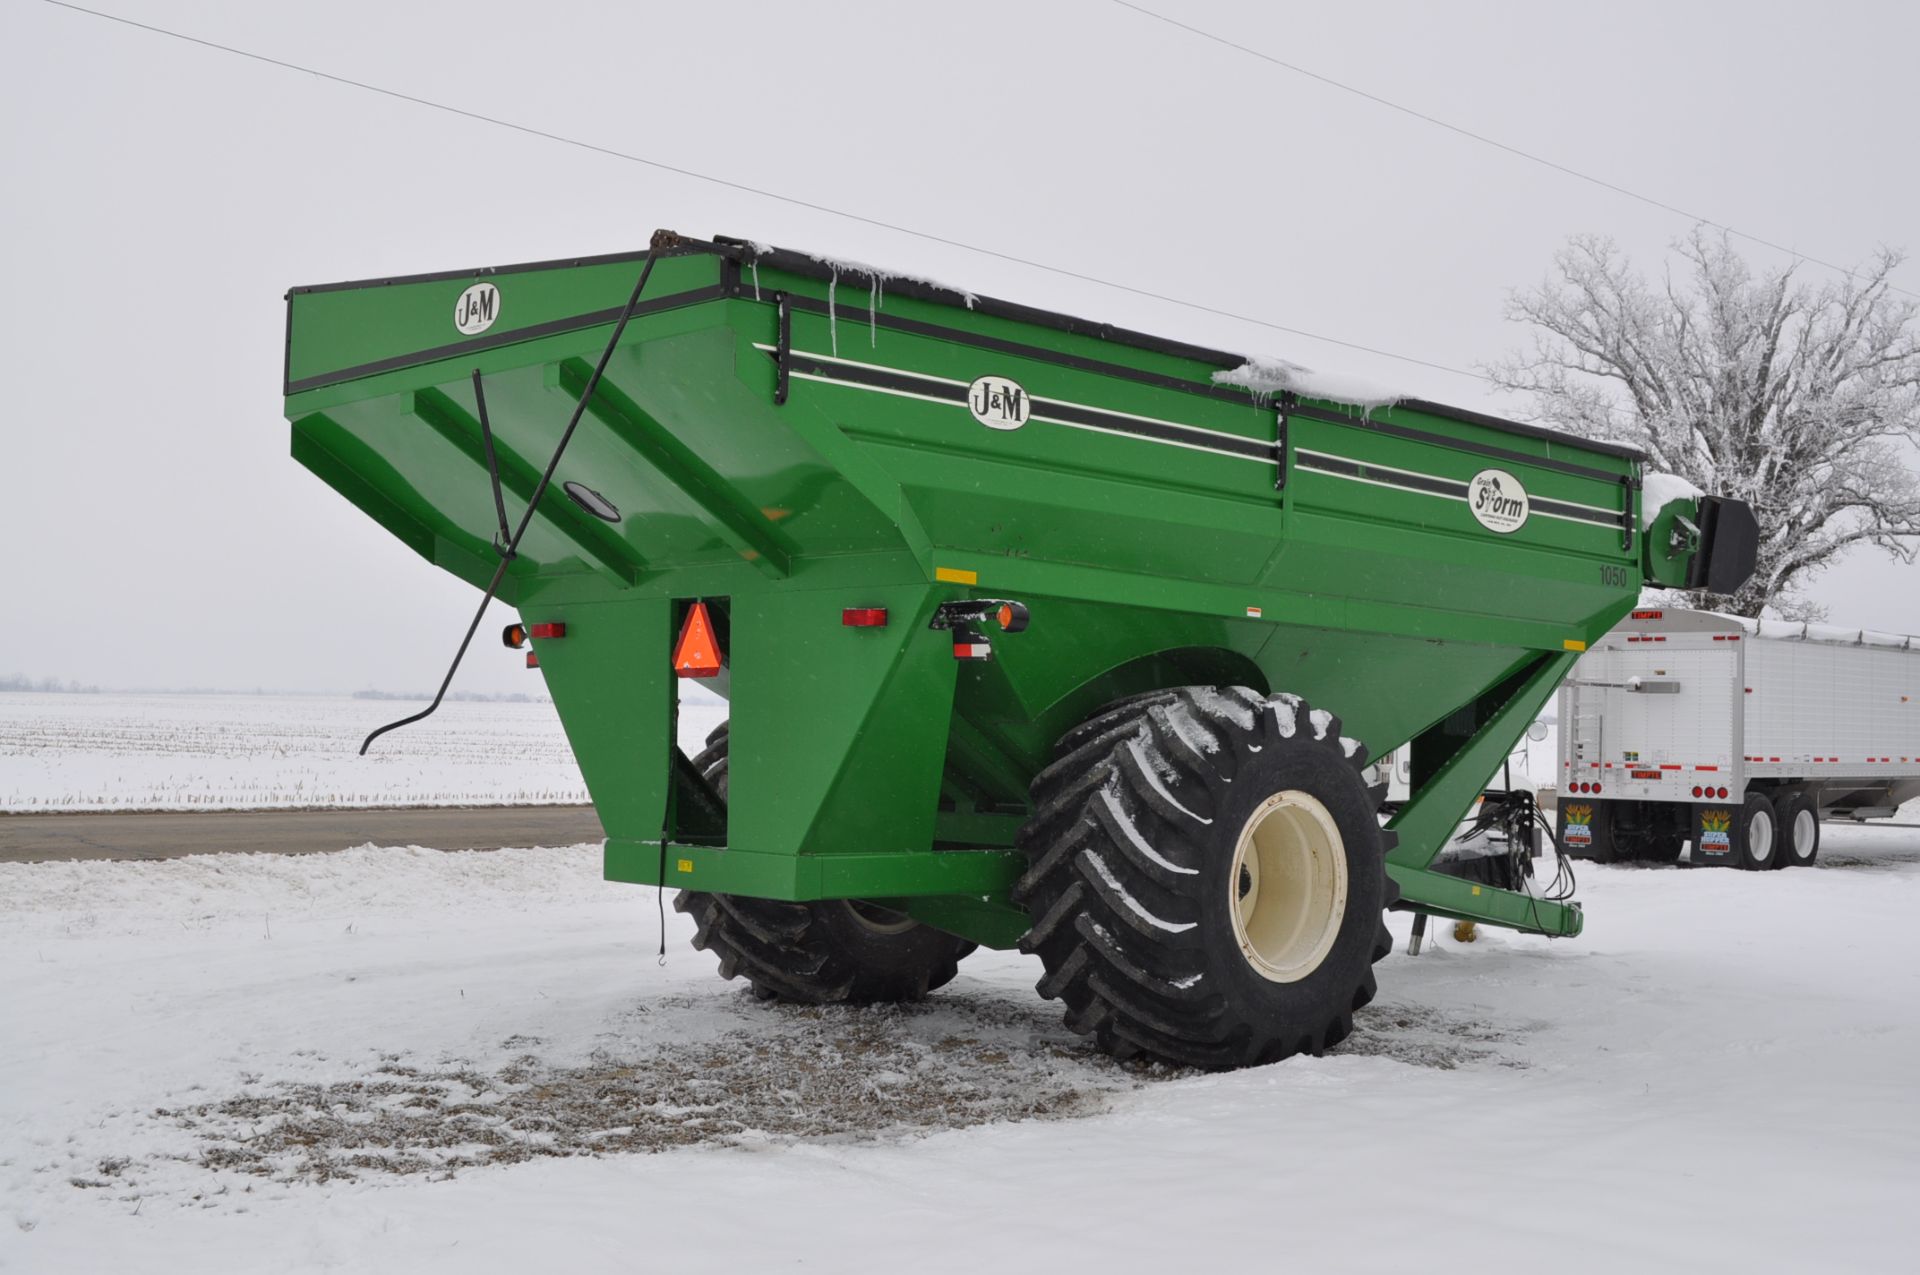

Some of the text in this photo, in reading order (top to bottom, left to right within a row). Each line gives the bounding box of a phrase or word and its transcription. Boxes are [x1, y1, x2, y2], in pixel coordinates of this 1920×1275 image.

[458, 287, 495, 328] J&M
[973, 381, 1022, 422] J&M
[1475, 486, 1523, 519] Storm
[1600, 564, 1627, 588] 1050
